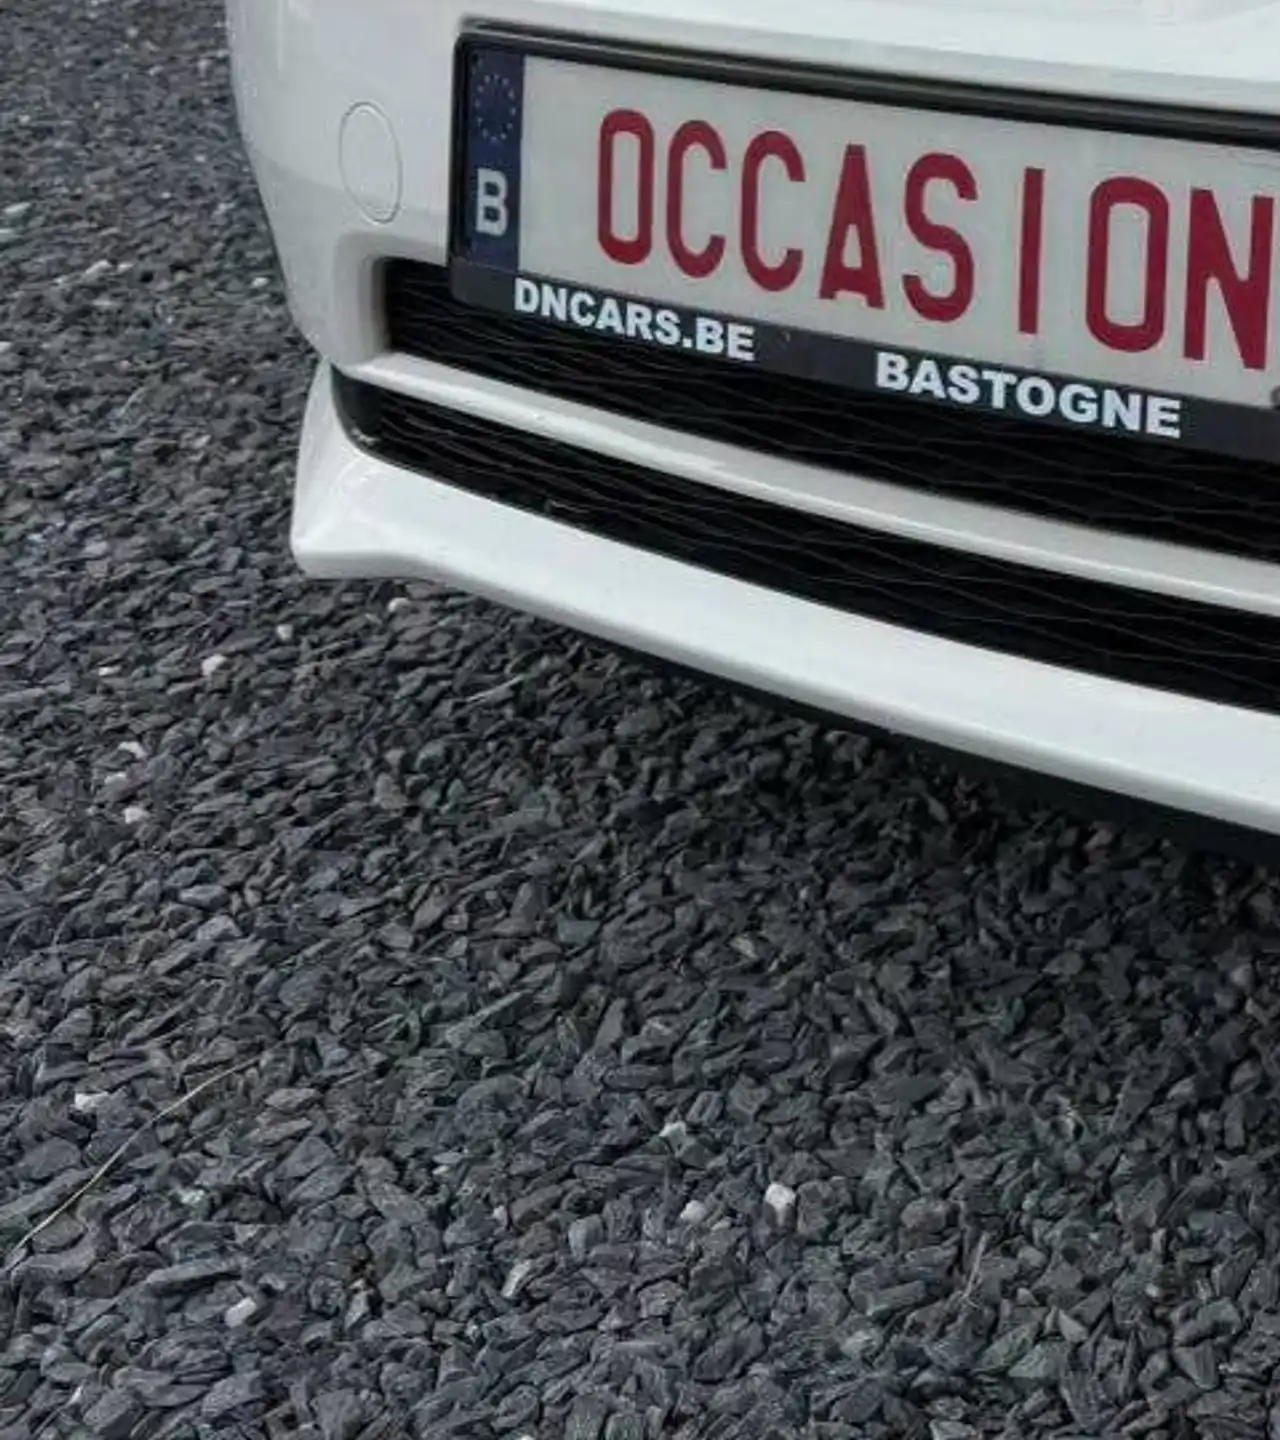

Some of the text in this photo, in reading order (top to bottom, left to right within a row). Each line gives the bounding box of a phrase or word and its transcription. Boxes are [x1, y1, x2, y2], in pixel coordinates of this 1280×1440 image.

[475, 168, 508, 237] B
[597, 109, 1275, 371] OCCASION
[514, 277, 756, 362] DNCARS.BE
[875, 351, 1182, 439] BASTOGNE
